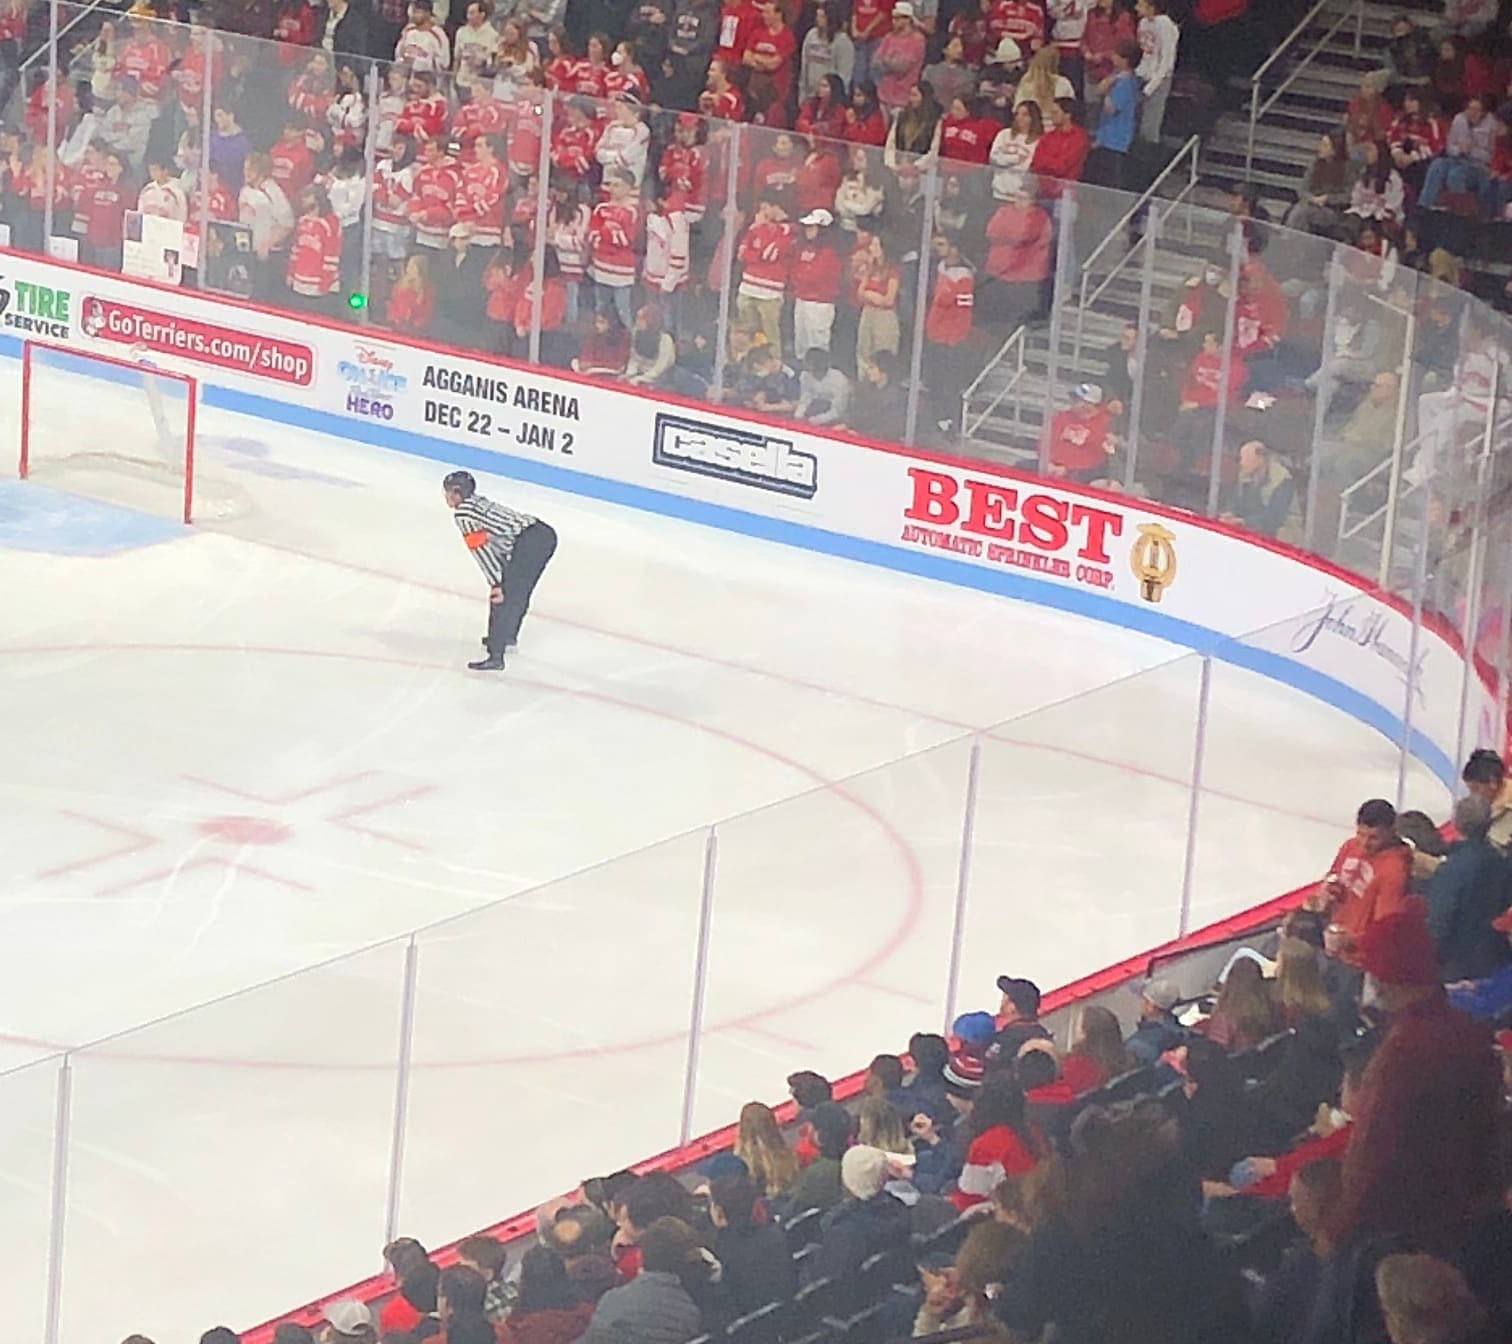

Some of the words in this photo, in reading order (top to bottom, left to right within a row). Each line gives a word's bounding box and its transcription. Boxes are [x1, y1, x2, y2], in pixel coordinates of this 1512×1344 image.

[14, 280, 71, 322] TIRE
[4, 312, 71, 340] SERVICE
[108, 309, 308, 380] GoTerriers.com/shop
[346, 393, 394, 421] HERO
[422, 365, 509, 404] AGGANIS
[513, 385, 581, 421] ARENA
[425, 400, 462, 429] DEC
[467, 409, 492, 436] 22
[515, 422, 555, 451] JAN
[561, 433, 575, 455] 2
[904, 466, 1124, 564] BEST
[901, 524, 983, 557] AUTOMATIC
